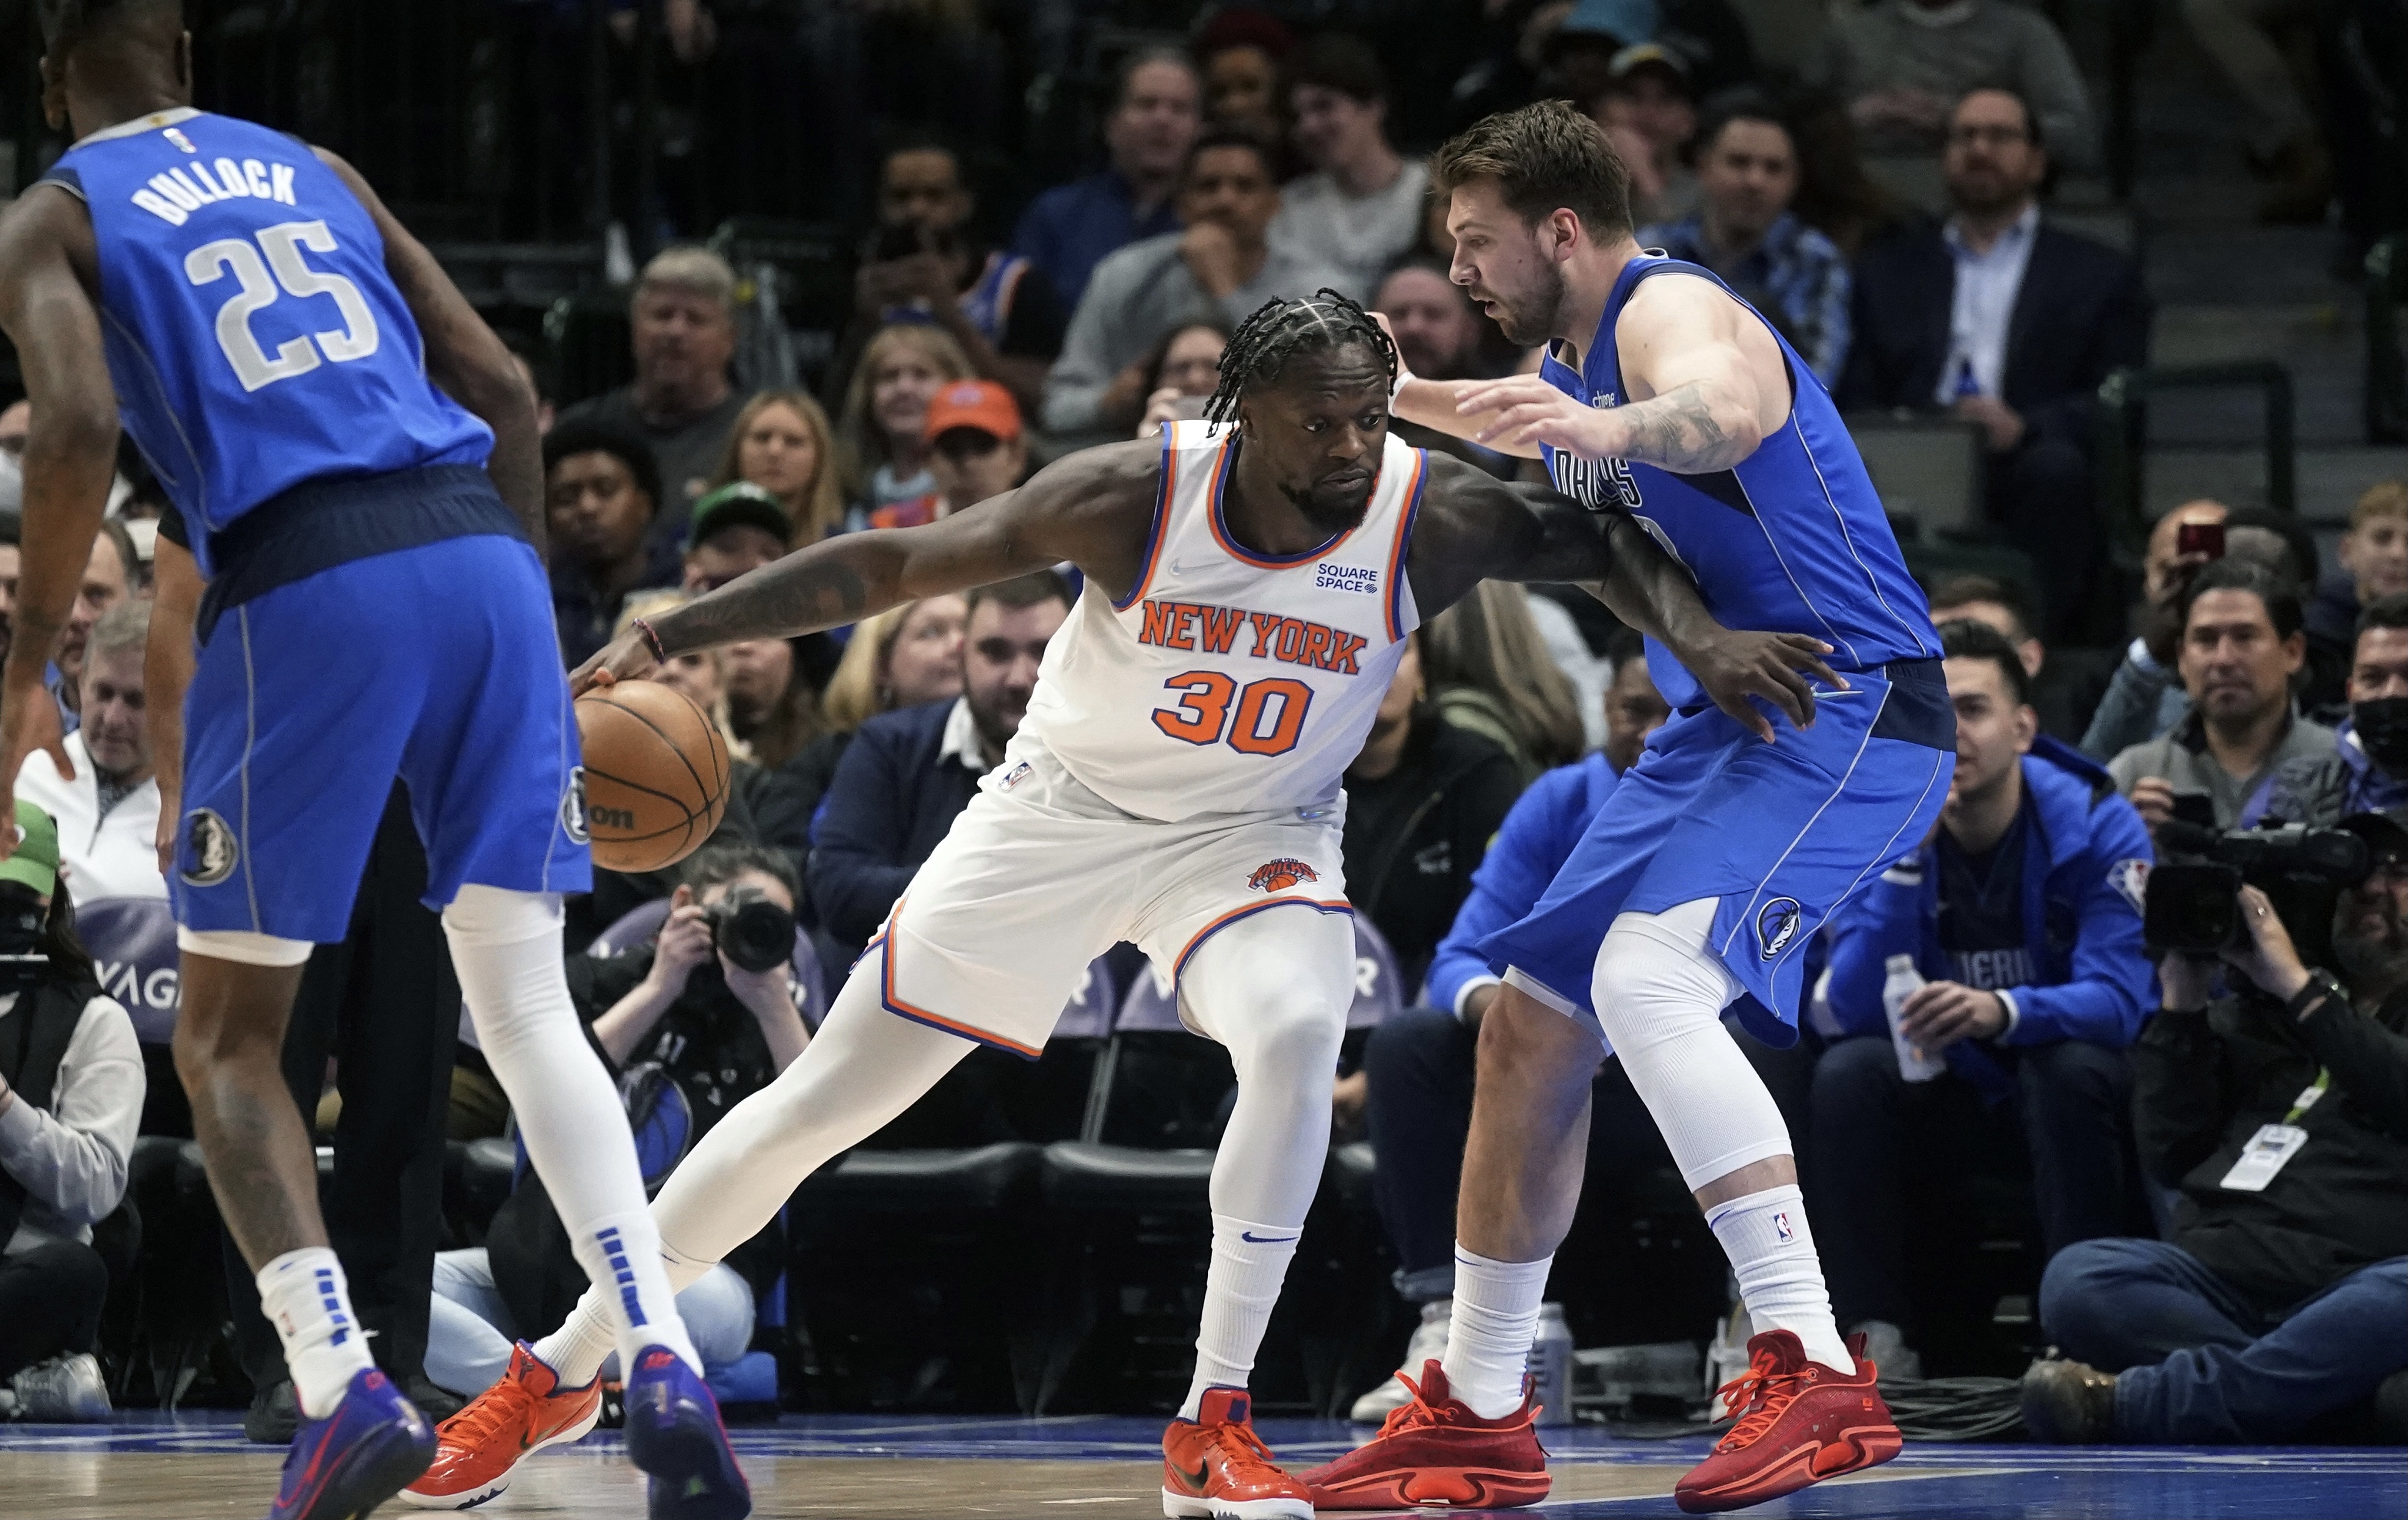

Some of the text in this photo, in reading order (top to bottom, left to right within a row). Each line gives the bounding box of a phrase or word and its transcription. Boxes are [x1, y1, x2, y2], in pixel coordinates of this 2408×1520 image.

[131, 157, 296, 226] BULLOCK
[184, 220, 379, 392] 25
[1315, 576, 1363, 592] SPACE
[1318, 563, 1378, 581] SQUARE
[1138, 599, 1369, 675] NEW YORK
[1151, 670, 1315, 758] 30
[1248, 862, 1318, 887] KNICKS
